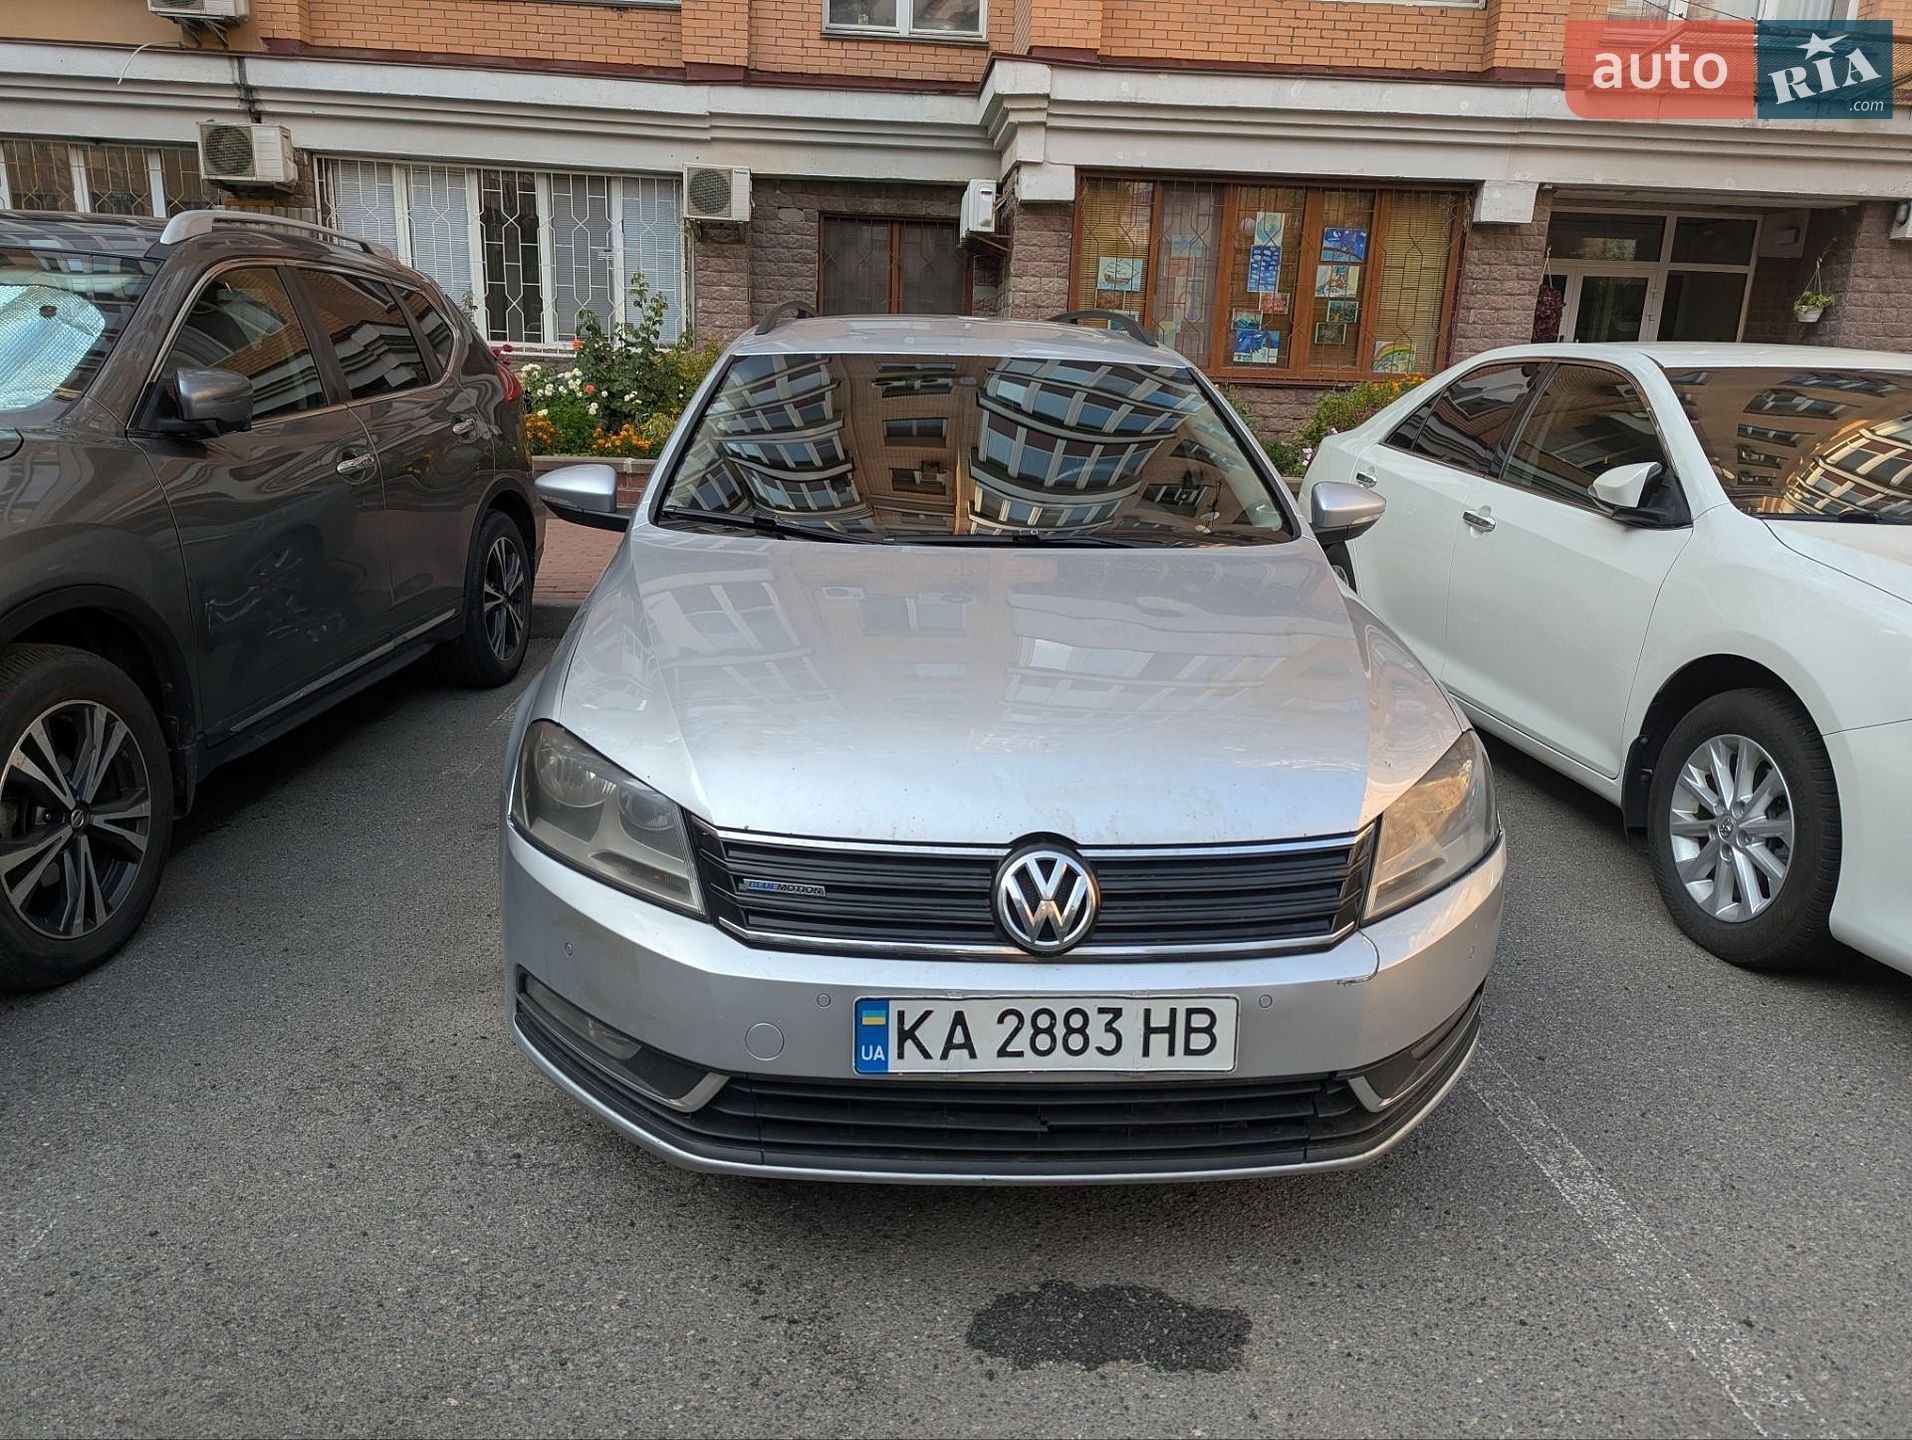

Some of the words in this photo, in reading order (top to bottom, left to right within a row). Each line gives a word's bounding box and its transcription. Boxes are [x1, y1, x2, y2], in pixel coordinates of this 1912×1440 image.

[897, 1009, 977, 1060] KA
[996, 1007, 1123, 1058] 2883
[1142, 1007, 1217, 1058] HB
[861, 1045, 885, 1061] UA
